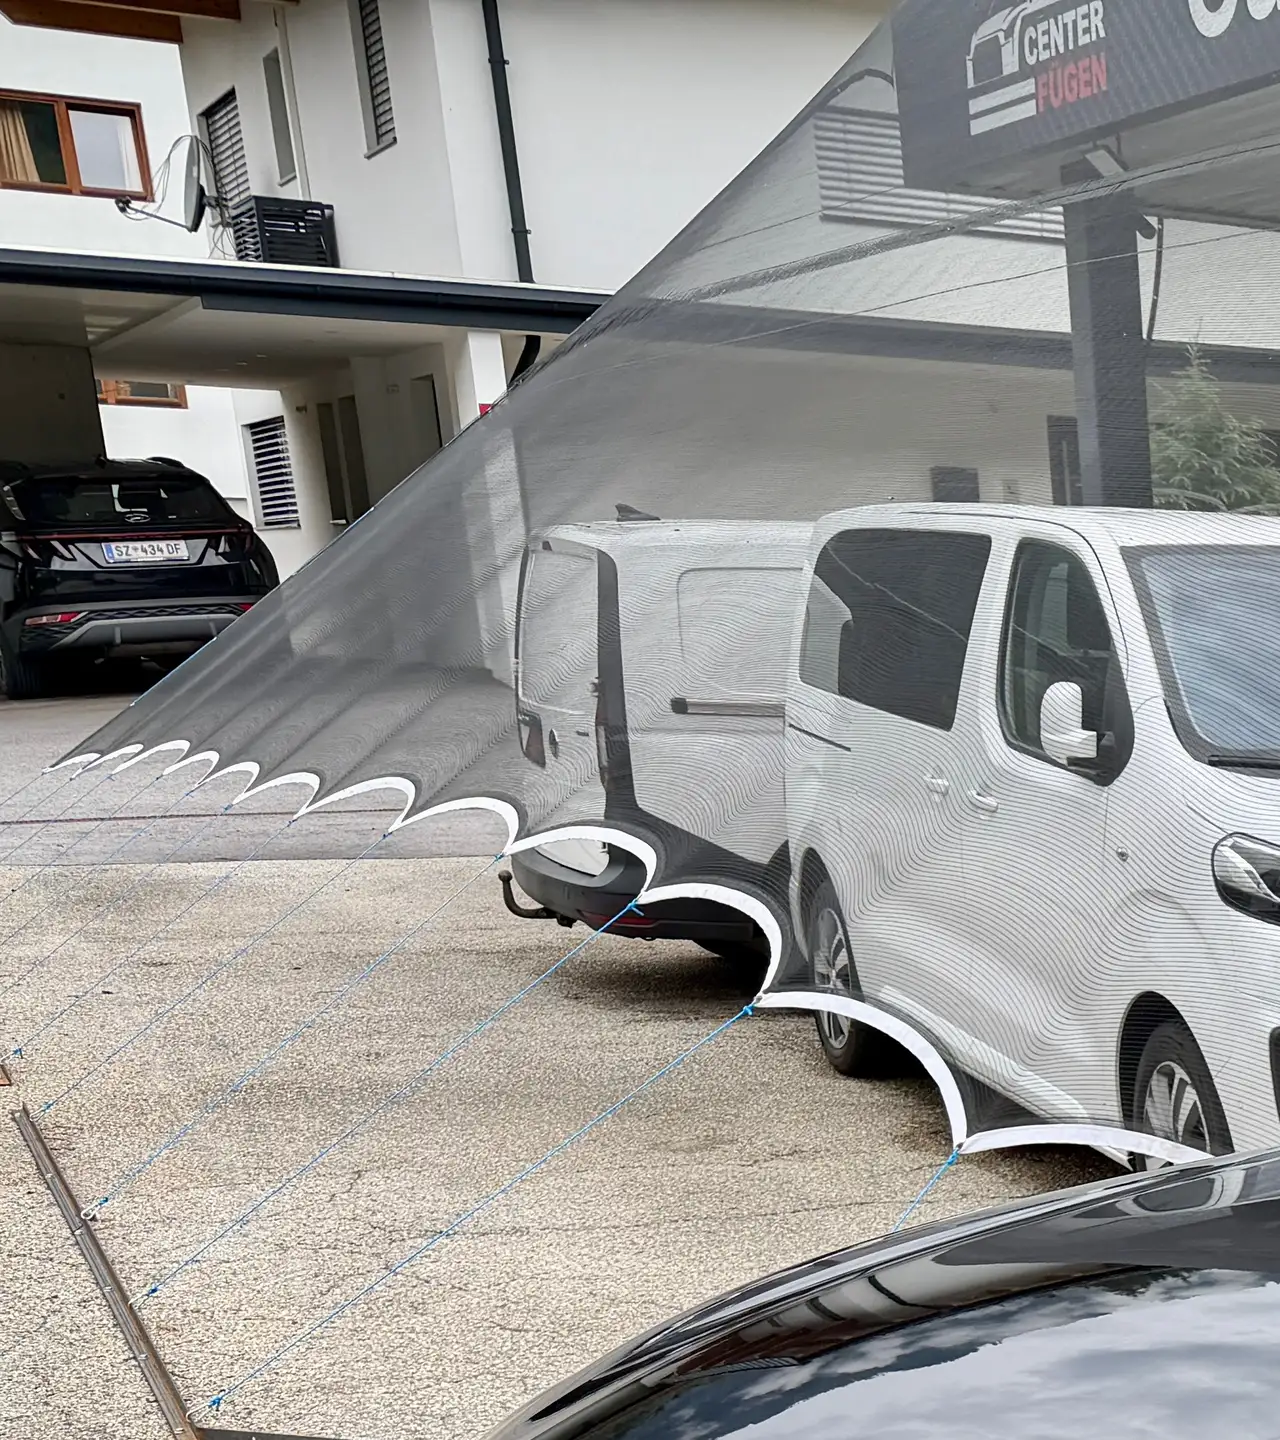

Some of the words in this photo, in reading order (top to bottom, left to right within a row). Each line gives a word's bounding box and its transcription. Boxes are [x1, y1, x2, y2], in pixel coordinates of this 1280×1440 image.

[1023, 0, 1107, 65] CENTER
[1036, 51, 1108, 113] FÜGEN
[114, 545, 131, 557] SZ
[141, 545, 164, 556] 434
[166, 543, 181, 555] DF
